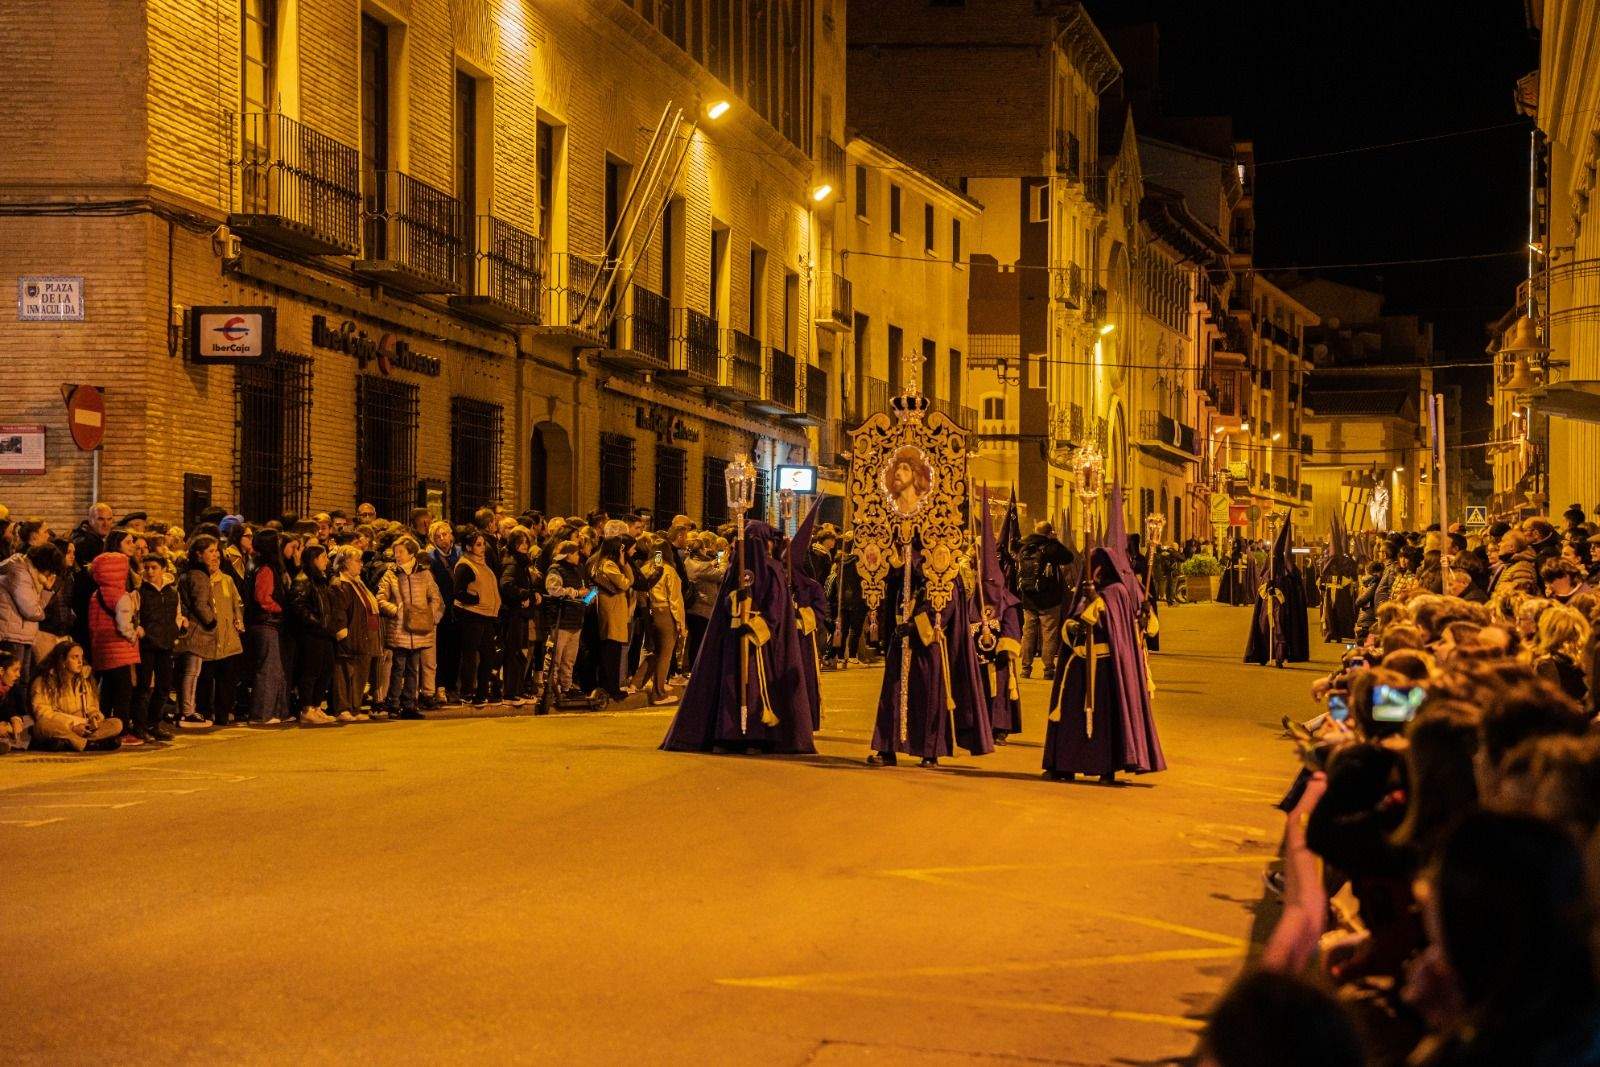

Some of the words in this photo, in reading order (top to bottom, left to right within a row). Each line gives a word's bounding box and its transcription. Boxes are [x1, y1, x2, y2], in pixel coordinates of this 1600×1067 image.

[45, 283, 73, 292] PLAZA
[41, 294, 55, 303] DE
[27, 304, 76, 315] INMACULDA
[212, 343, 250, 353] IberCaja
